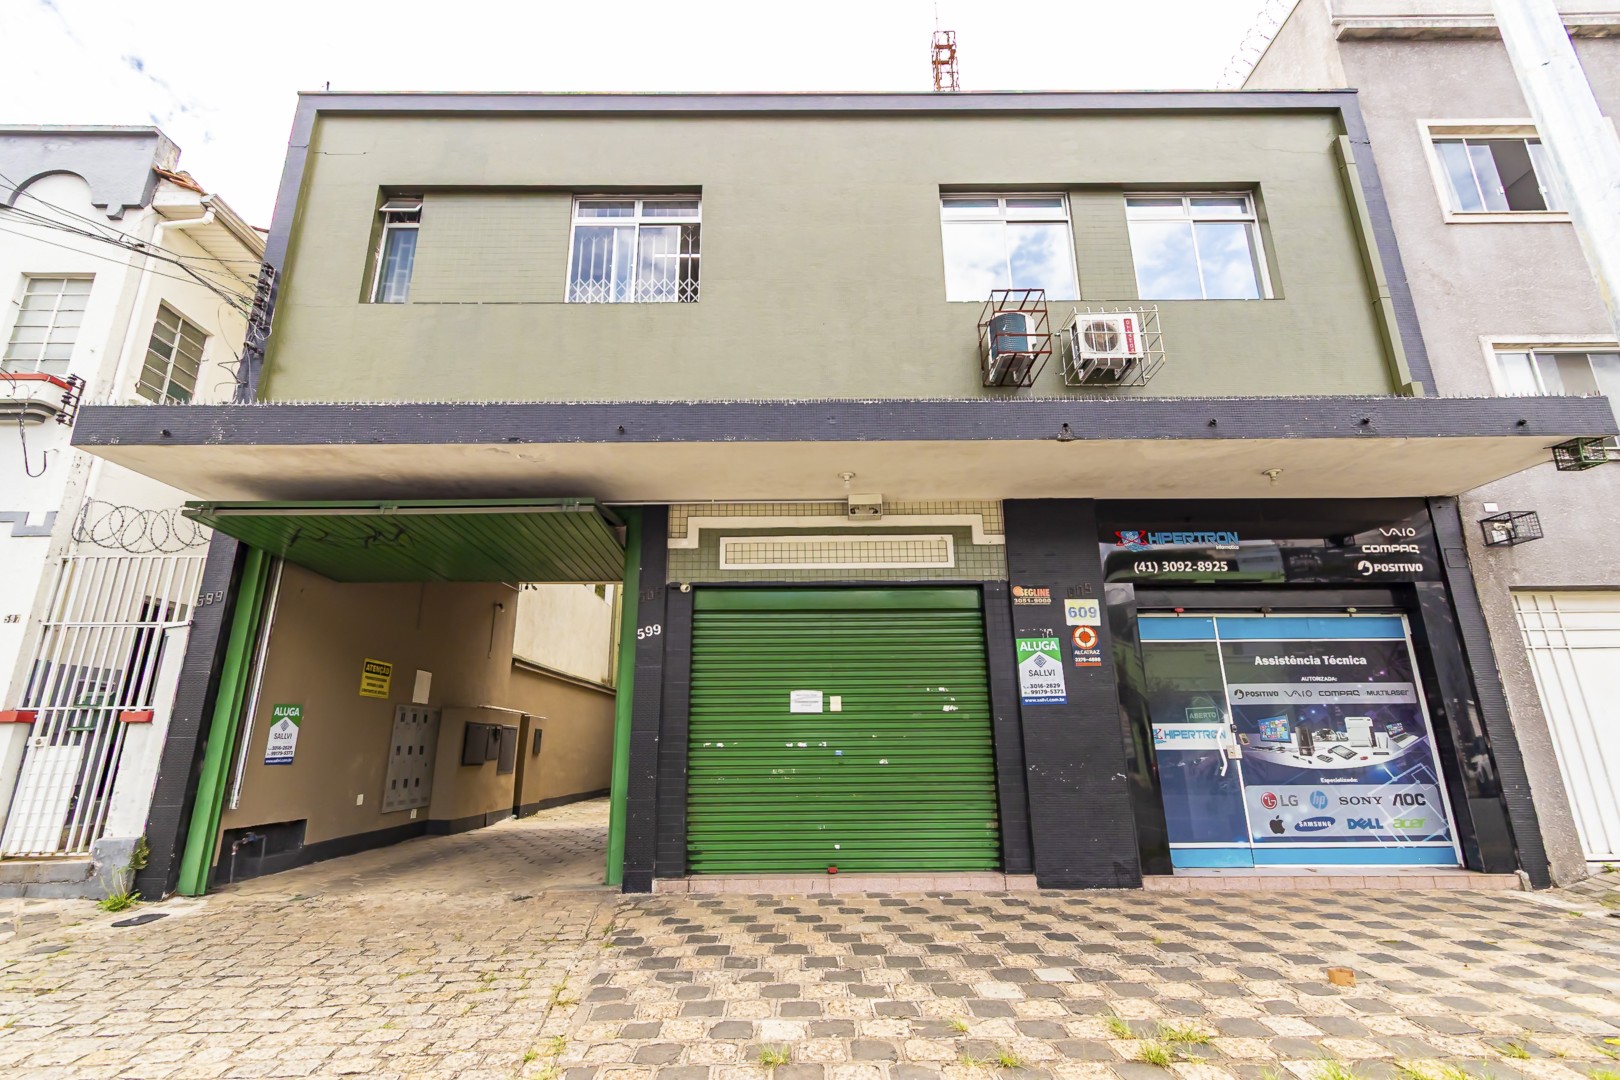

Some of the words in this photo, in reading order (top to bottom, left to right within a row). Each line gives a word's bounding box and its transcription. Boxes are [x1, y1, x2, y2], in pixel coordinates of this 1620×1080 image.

[1379, 527, 1416, 537] VAIO
[1148, 531, 1240, 545] HIPERTRON
[1362, 544, 1420, 554] COMPAQ
[1134, 561, 1159, 574] (41)
[1162, 561, 1229, 572] 3092-8925
[1373, 563, 1424, 573] POSITIVO
[196, 590, 224, 607] 599
[1068, 606, 1098, 619] 609
[637, 624, 662, 640] 599
[1020, 641, 1058, 652] ALUGA
[1254, 655, 1322, 666] Assistência
[1324, 654, 1368, 666] Técnica
[1028, 669, 1056, 677] SALLVI
[1284, 689, 1313, 698] VAIO
[273, 706, 300, 717] ALUGA
[1189, 711, 1217, 719] ABERTO
[273, 732, 293, 740] SALLVI
[1280, 795, 1299, 807] LG
[1339, 796, 1383, 806] SONY
[1392, 793, 1427, 806] AOC
[1298, 820, 1332, 828] SAMSUNG
[1347, 817, 1384, 830] DELL
[1393, 818, 1426, 829] acer
